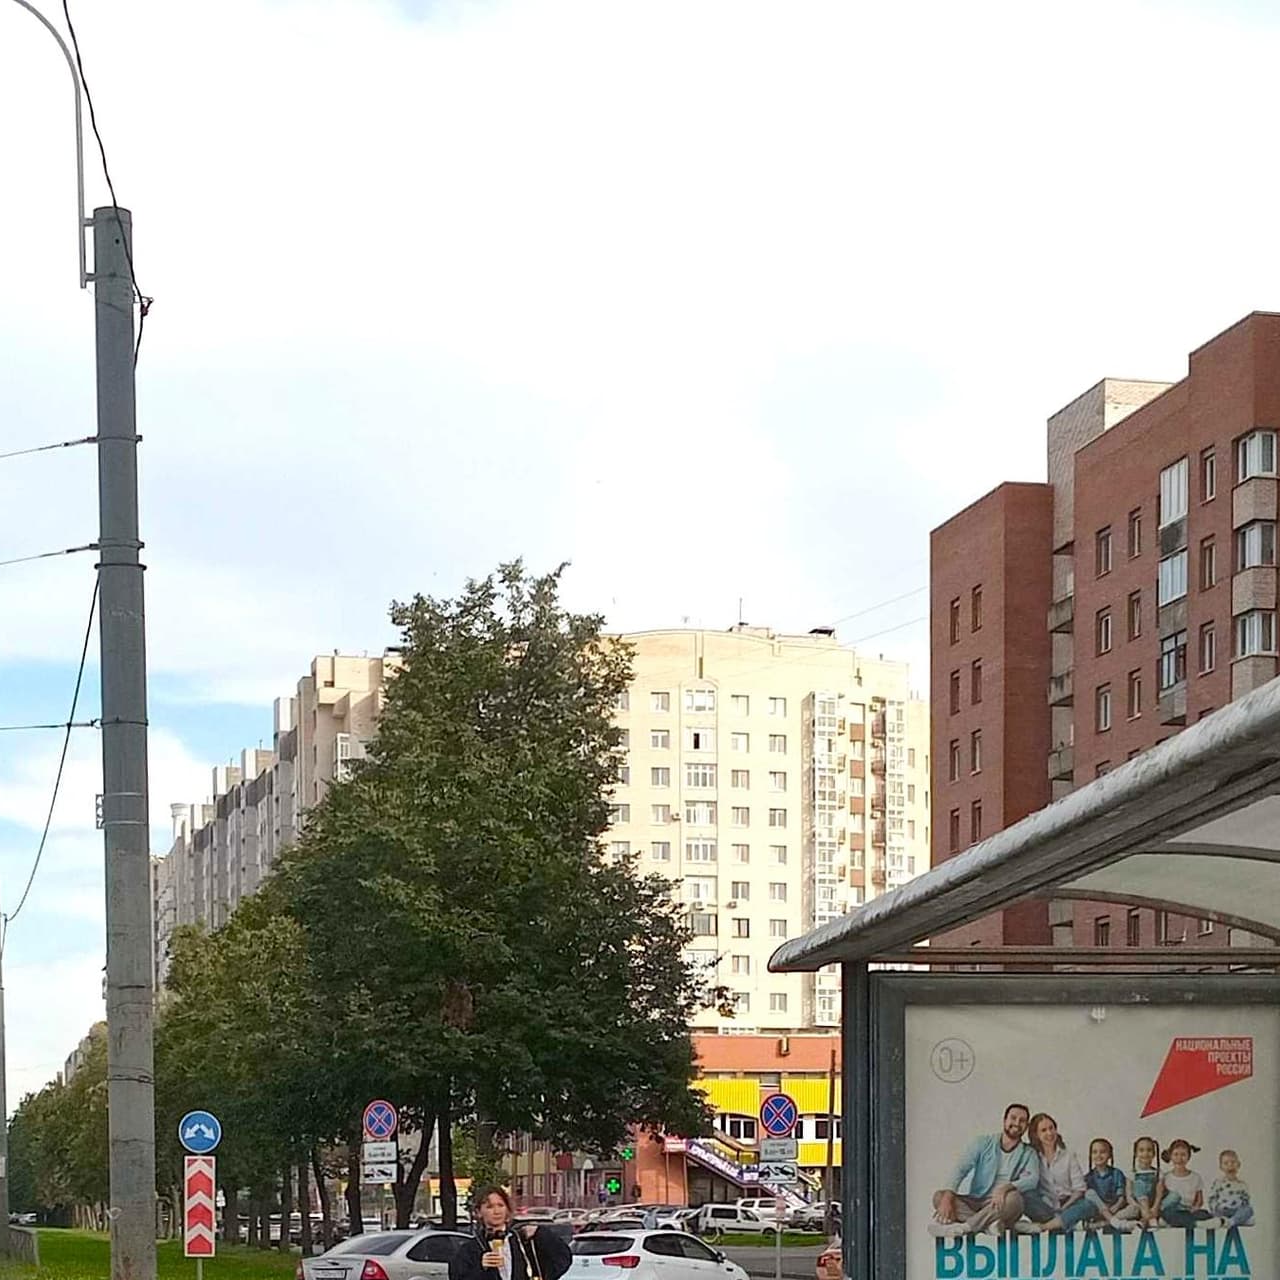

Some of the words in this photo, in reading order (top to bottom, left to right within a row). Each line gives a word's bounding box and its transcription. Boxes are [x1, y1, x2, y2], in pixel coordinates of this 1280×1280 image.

[1175, 1039, 1251, 1051] НАЦИОНАЛЬНЫЕ
[939, 1047, 969, 1073] 0+
[1207, 1051, 1251, 1064] ПРОЕКТЫ
[935, 1229, 1165, 1279] ВЫПЛАТА
[1185, 1226, 1251, 1276] НА
